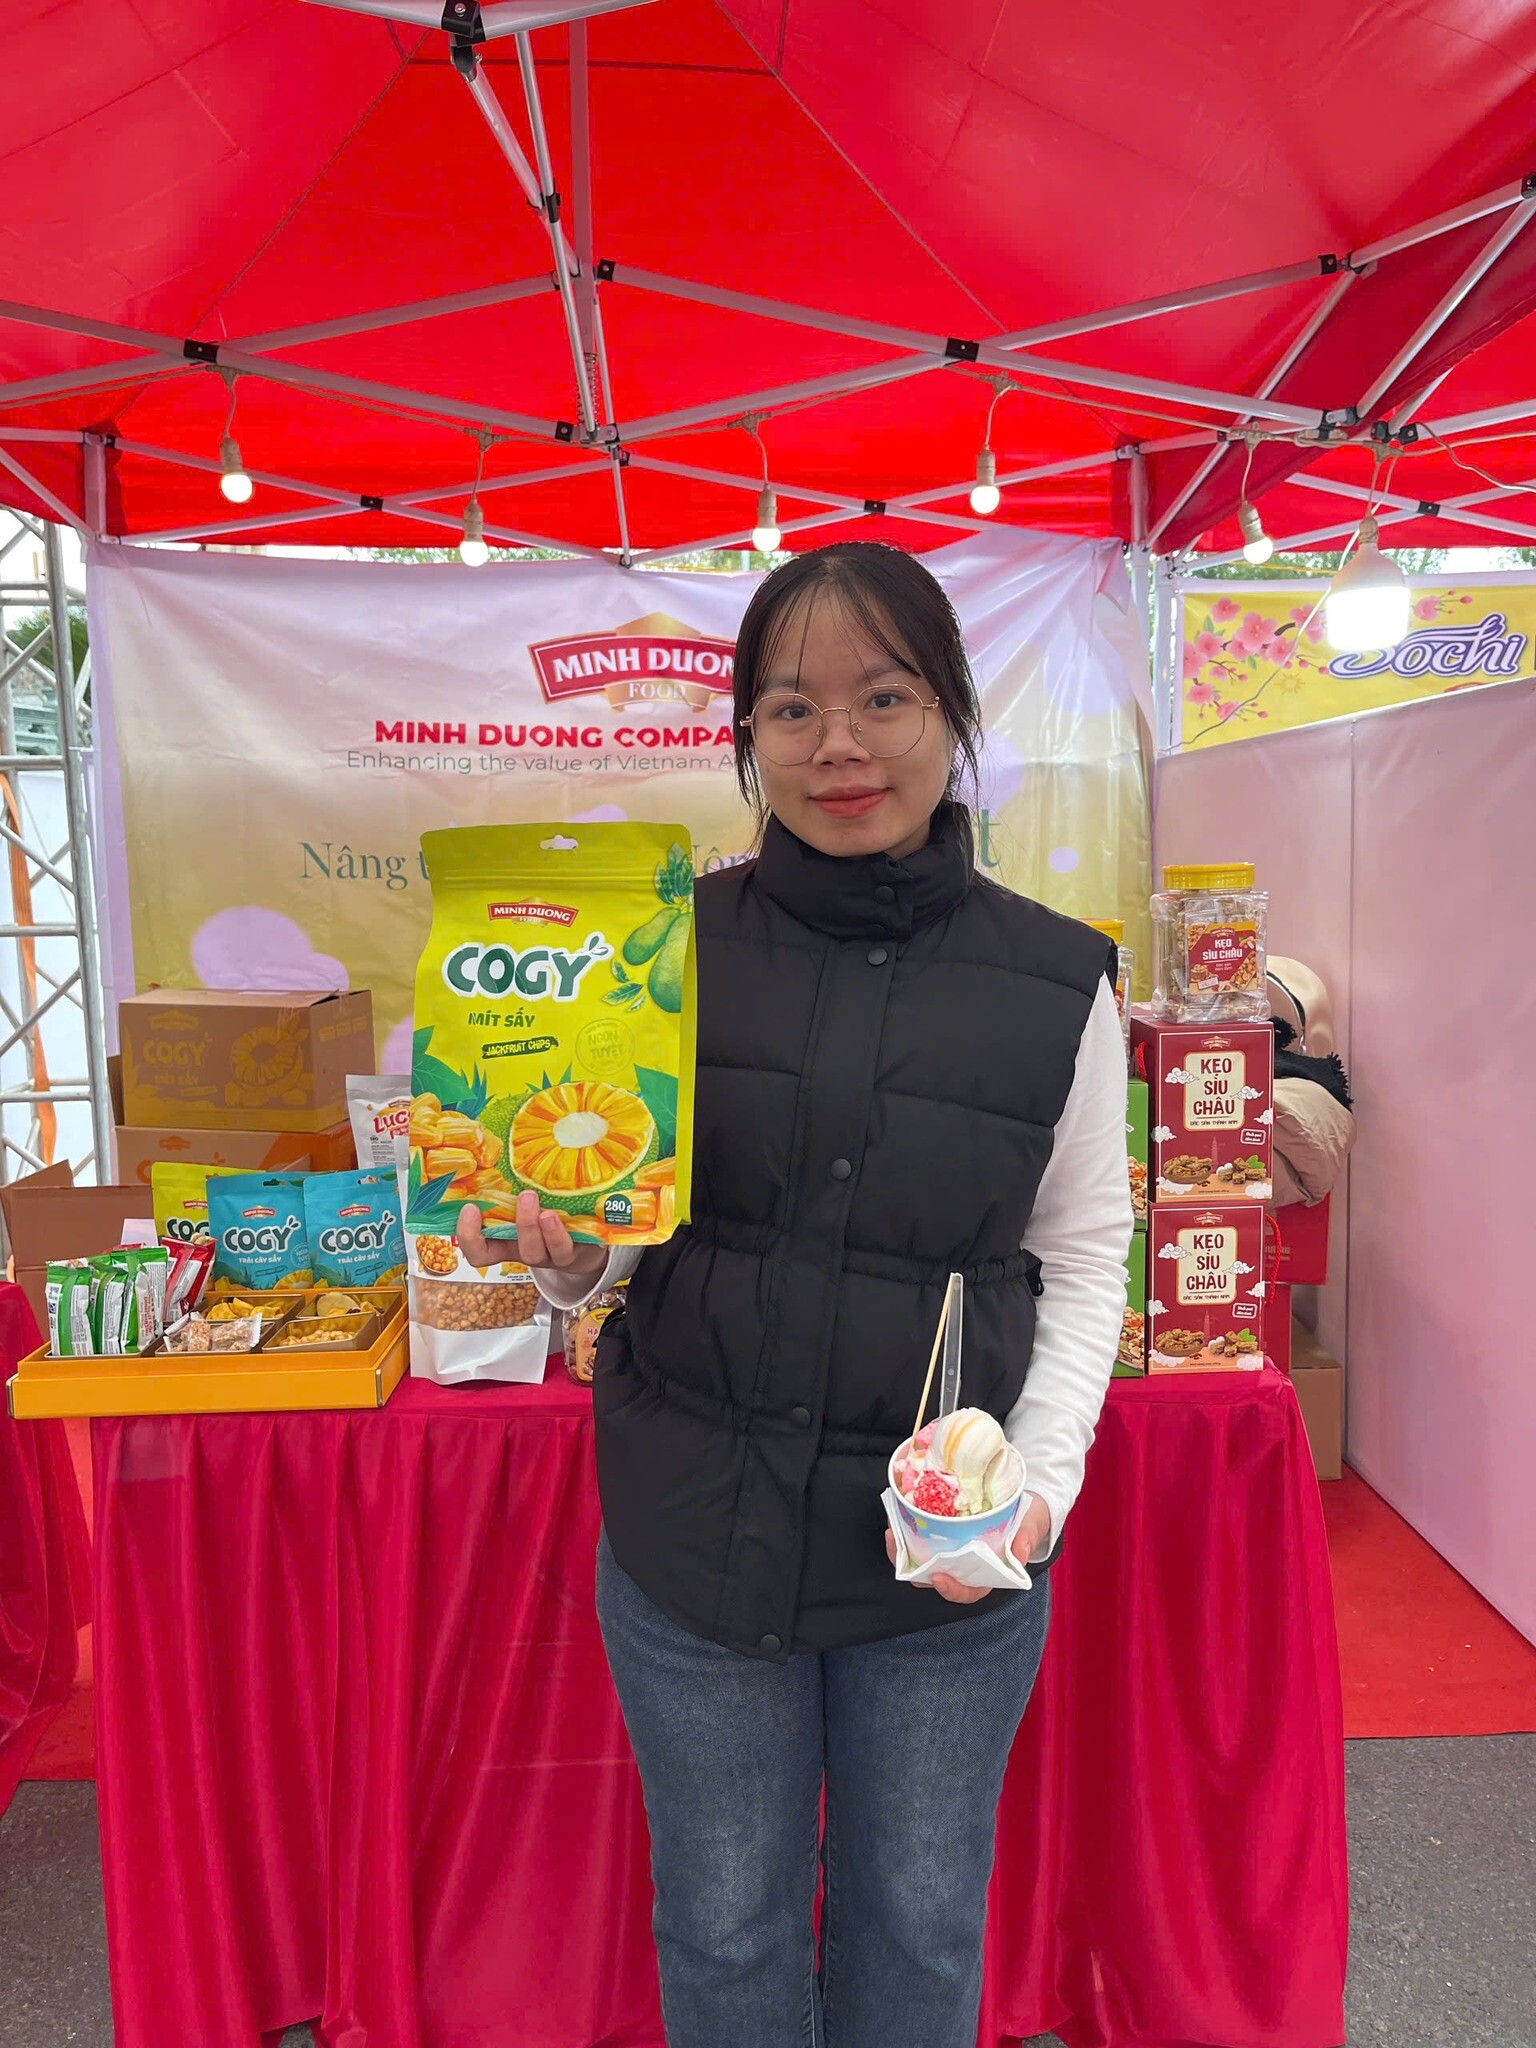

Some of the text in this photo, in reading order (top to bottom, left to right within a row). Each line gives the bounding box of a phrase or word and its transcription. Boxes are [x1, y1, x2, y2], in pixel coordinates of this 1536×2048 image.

[552, 647, 735, 683] MINH DUON
[628, 682, 687, 700] FOOD
[375, 720, 735, 748] MINH DUONG COMPA
[347, 750, 472, 775] Enhancing
[479, 753, 517, 771] the
[522, 754, 583, 771] value
[589, 754, 612, 771] of
[616, 754, 711, 770] Vietnam
[297, 841, 408, 891] Nâng
[494, 906, 571, 922] MINH DUONG
[1202, 947, 1243, 960] SÌU CHÂU
[1214, 938, 1232, 950] KẸO
[444, 944, 595, 999] COGY
[468, 1006, 536, 1028] MÍT SẤY
[143, 1039, 206, 1068] COGY
[1200, 1057, 1232, 1077] KẸO
[1204, 1076, 1228, 1096] SÌU
[1193, 1096, 1235, 1116] CHÂU
[373, 1109, 408, 1134] LUC
[224, 1227, 292, 1252] COGY
[321, 1222, 388, 1253] COGY
[1193, 1233, 1224, 1252] KẸO
[1196, 1251, 1220, 1271] SÌU
[1186, 1271, 1227, 1290] CHÂU
